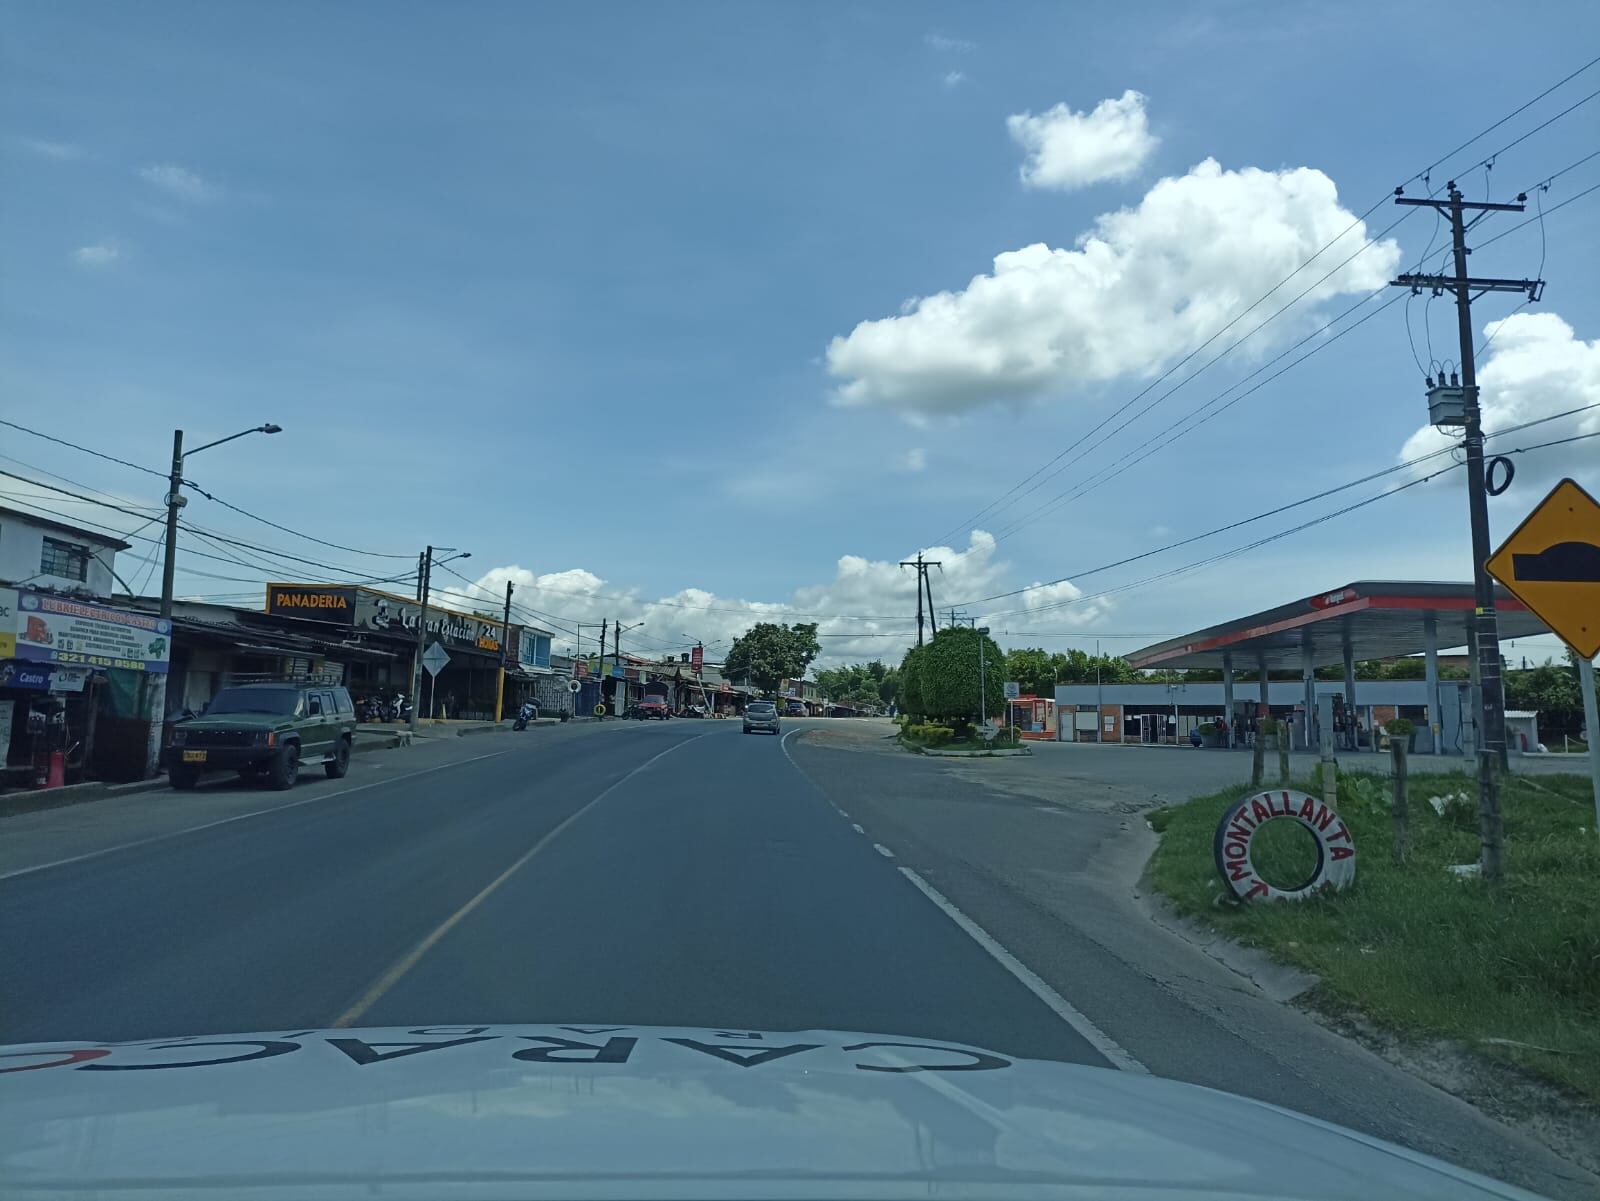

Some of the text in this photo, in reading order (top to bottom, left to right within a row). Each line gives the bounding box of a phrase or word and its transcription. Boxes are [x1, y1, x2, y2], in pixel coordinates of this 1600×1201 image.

[276, 593, 347, 609] PANADERIA
[485, 626, 496, 638] 24
[20, 672, 44, 684] Castro
[1224, 791, 1355, 882] MONTALLANTA
